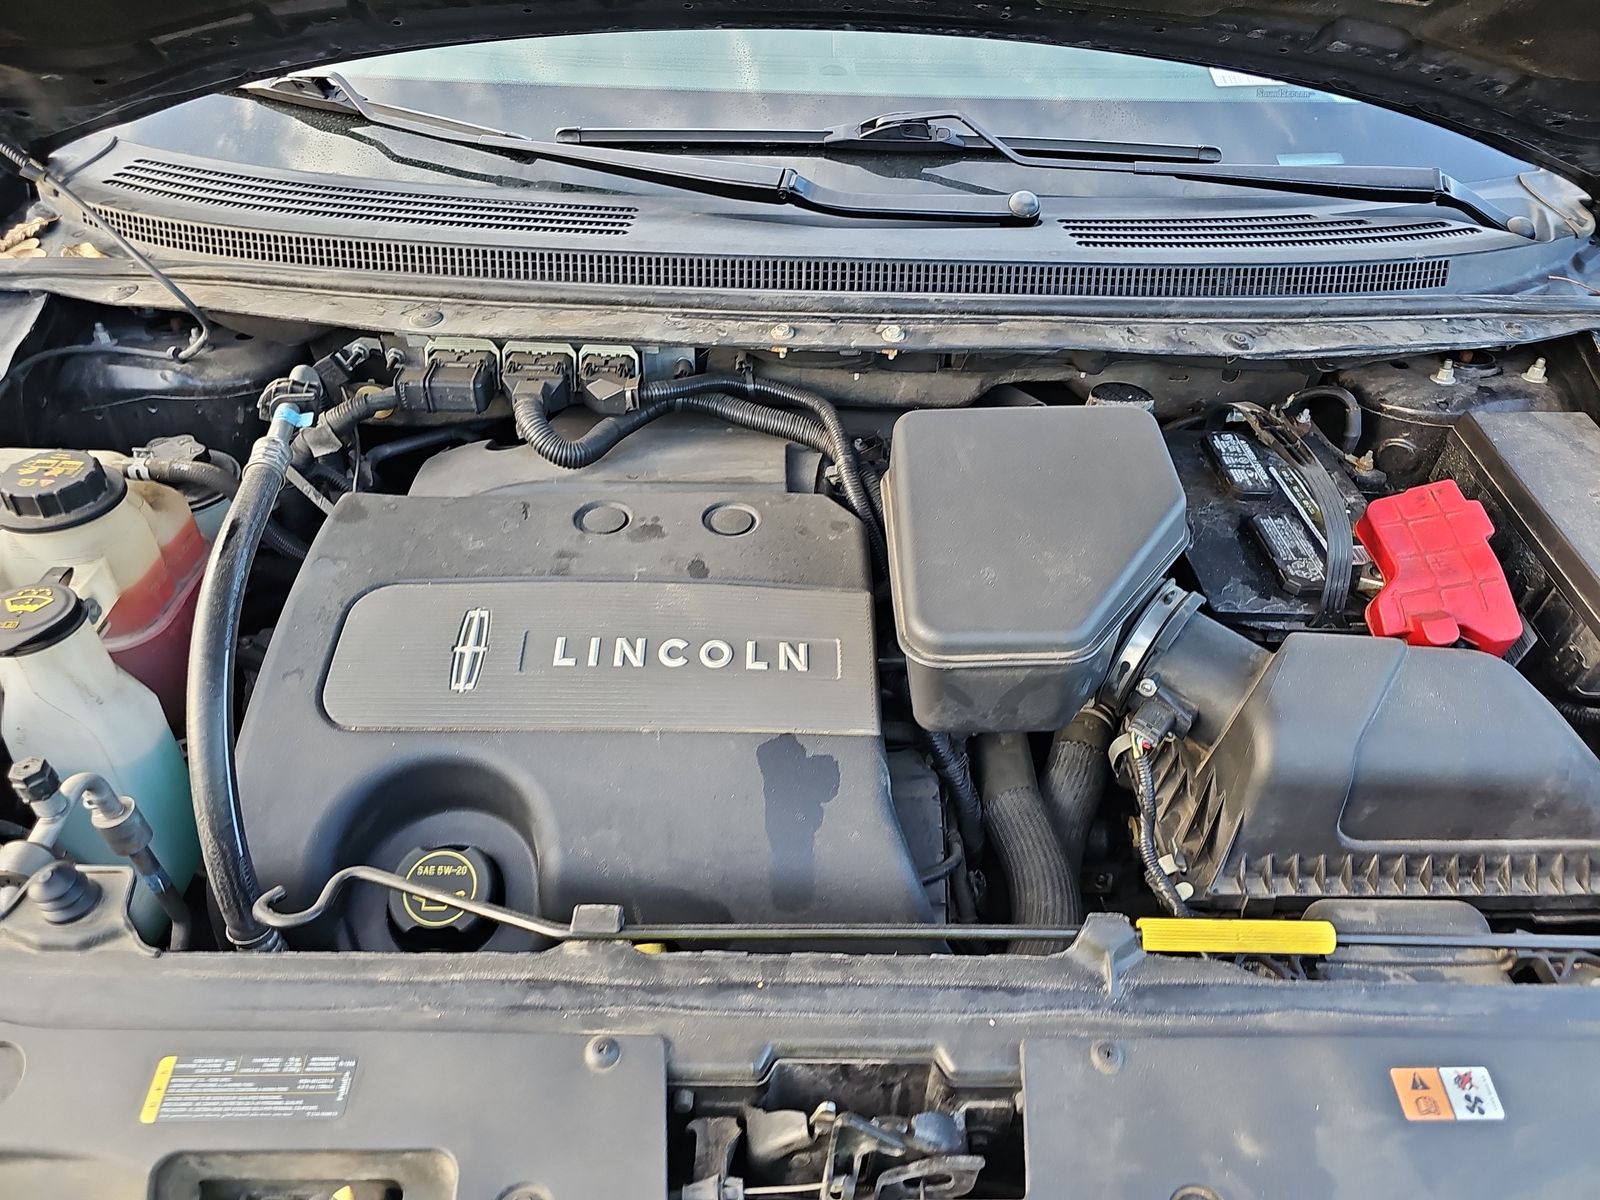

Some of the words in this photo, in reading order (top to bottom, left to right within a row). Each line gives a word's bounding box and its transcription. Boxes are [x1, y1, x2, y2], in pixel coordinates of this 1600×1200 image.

[552, 636, 809, 672] LINCOLN
[416, 865, 436, 876] SAE
[436, 865, 468, 876] 5W-20
